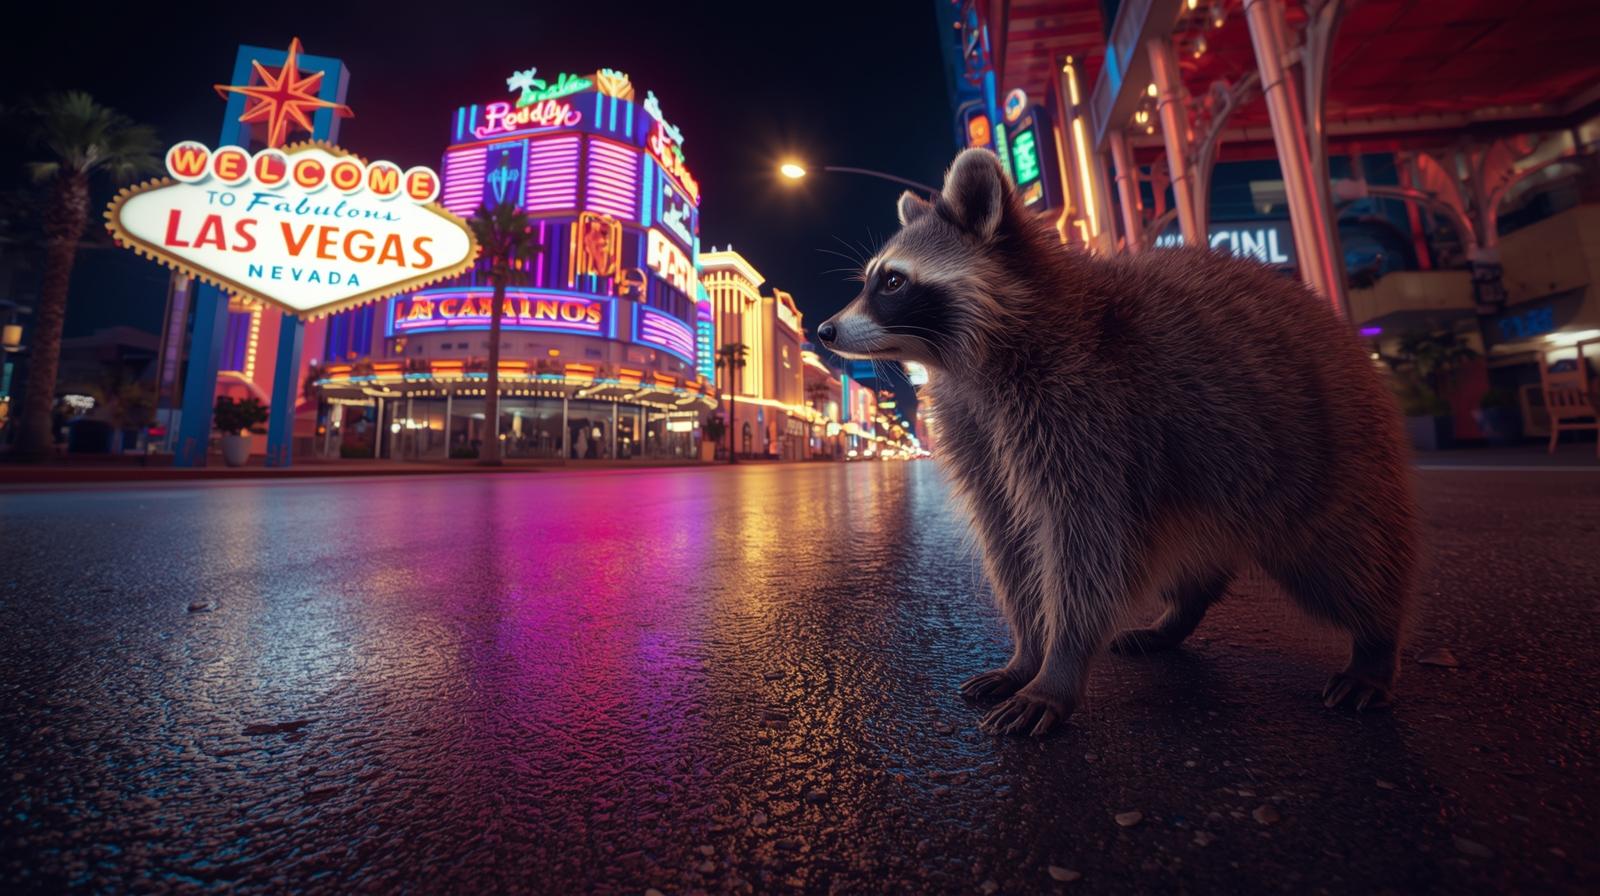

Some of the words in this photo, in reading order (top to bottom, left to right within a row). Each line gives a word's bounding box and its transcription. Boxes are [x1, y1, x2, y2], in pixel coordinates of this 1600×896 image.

[173, 146, 431, 198] WELCOME
[207, 191, 236, 206] TO
[165, 209, 257, 253] LAS
[280, 221, 434, 269] VEGAS
[248, 264, 360, 287] NEVADA
